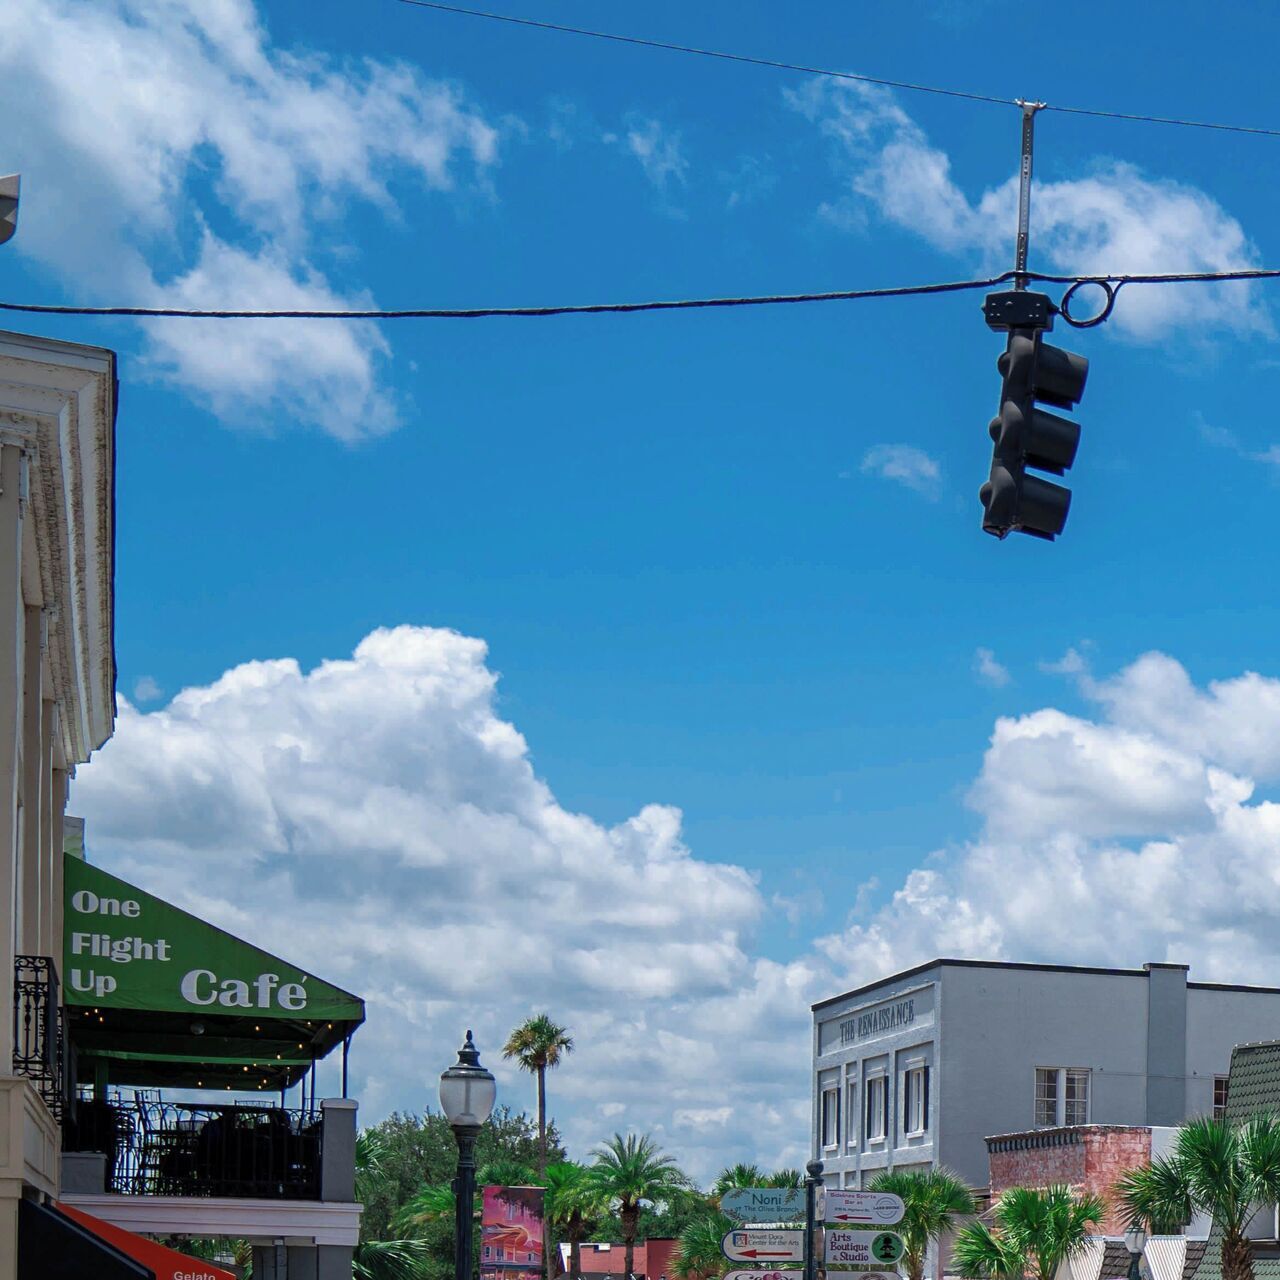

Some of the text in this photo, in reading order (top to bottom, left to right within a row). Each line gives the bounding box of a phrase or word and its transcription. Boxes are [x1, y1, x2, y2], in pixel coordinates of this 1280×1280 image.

[71, 889, 141, 918] One
[71, 932, 171, 963] Flight
[71, 968, 117, 997] Up
[180, 969, 307, 1010] Café
[752, 1193, 782, 1205] Noni
[830, 1232, 852, 1242] Arts
[830, 1241, 869, 1252] Boutique
[840, 1251, 869, 1261] Studio
